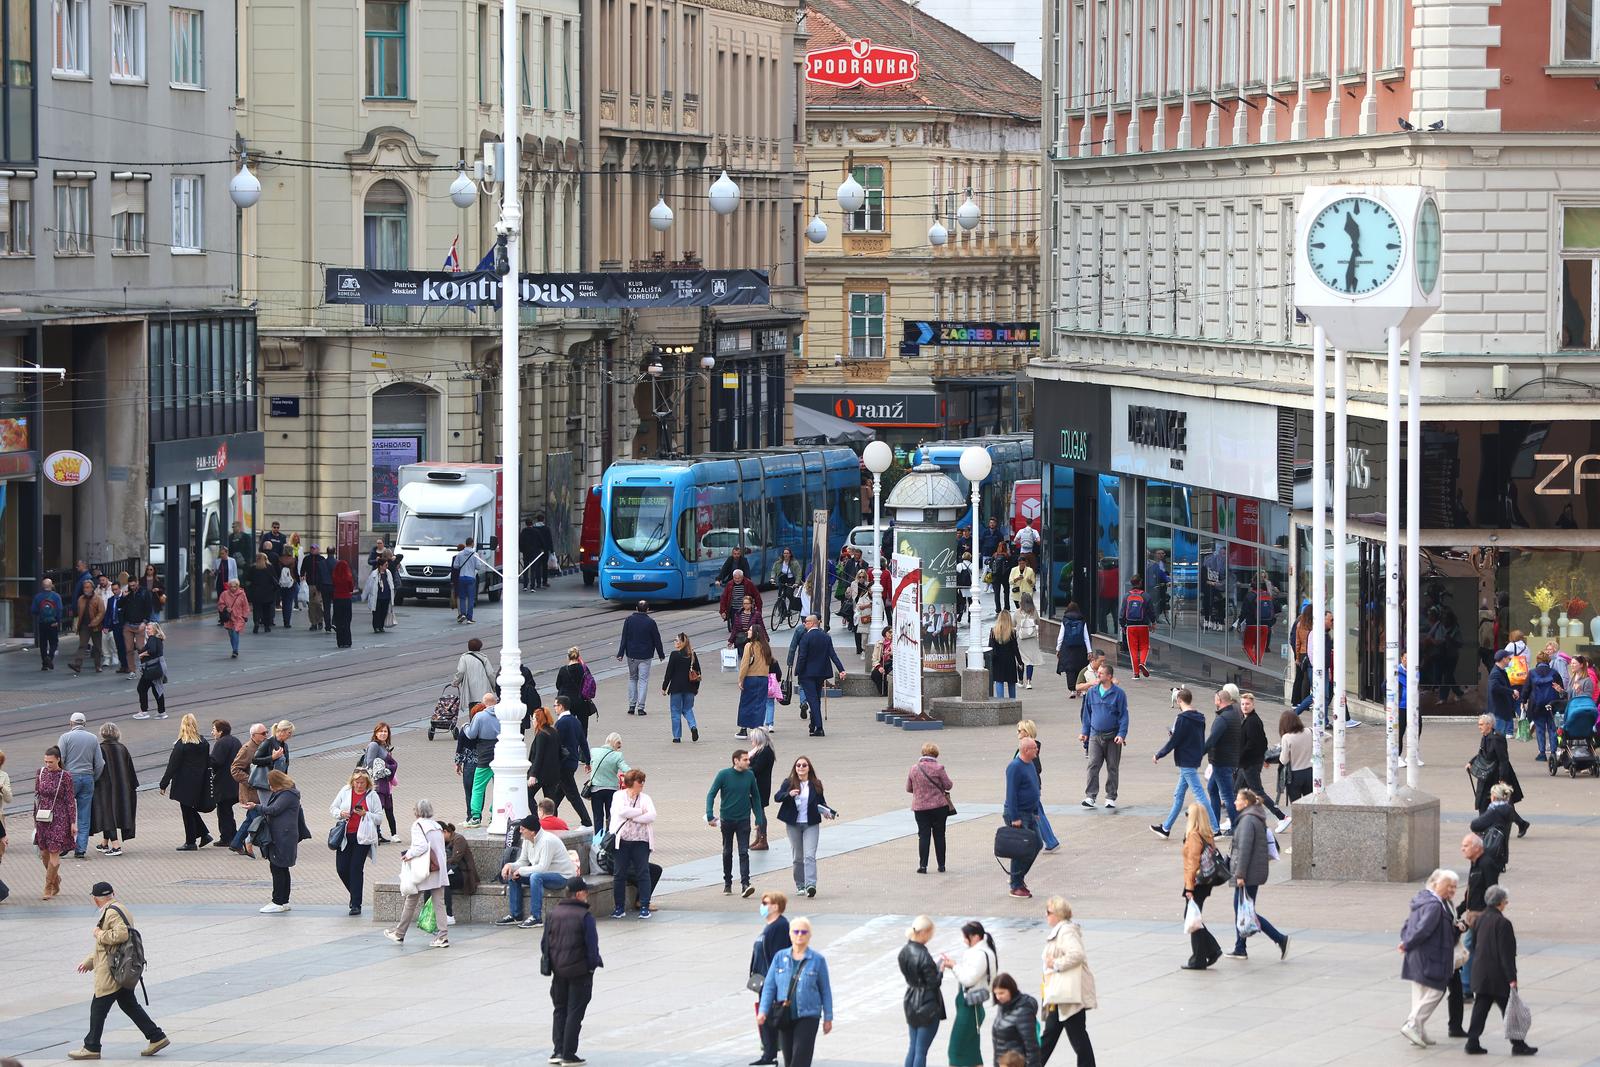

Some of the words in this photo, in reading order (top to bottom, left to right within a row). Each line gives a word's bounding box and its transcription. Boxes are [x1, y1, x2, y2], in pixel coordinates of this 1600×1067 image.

[814, 59, 908, 74] PODRAVKA
[422, 277, 575, 303] kontrbas
[941, 328, 993, 340] ZAGREB
[996, 329, 1027, 341] FILM
[1061, 429, 1087, 460] DOUGLAS
[196, 455, 217, 470] PAN-PEK
